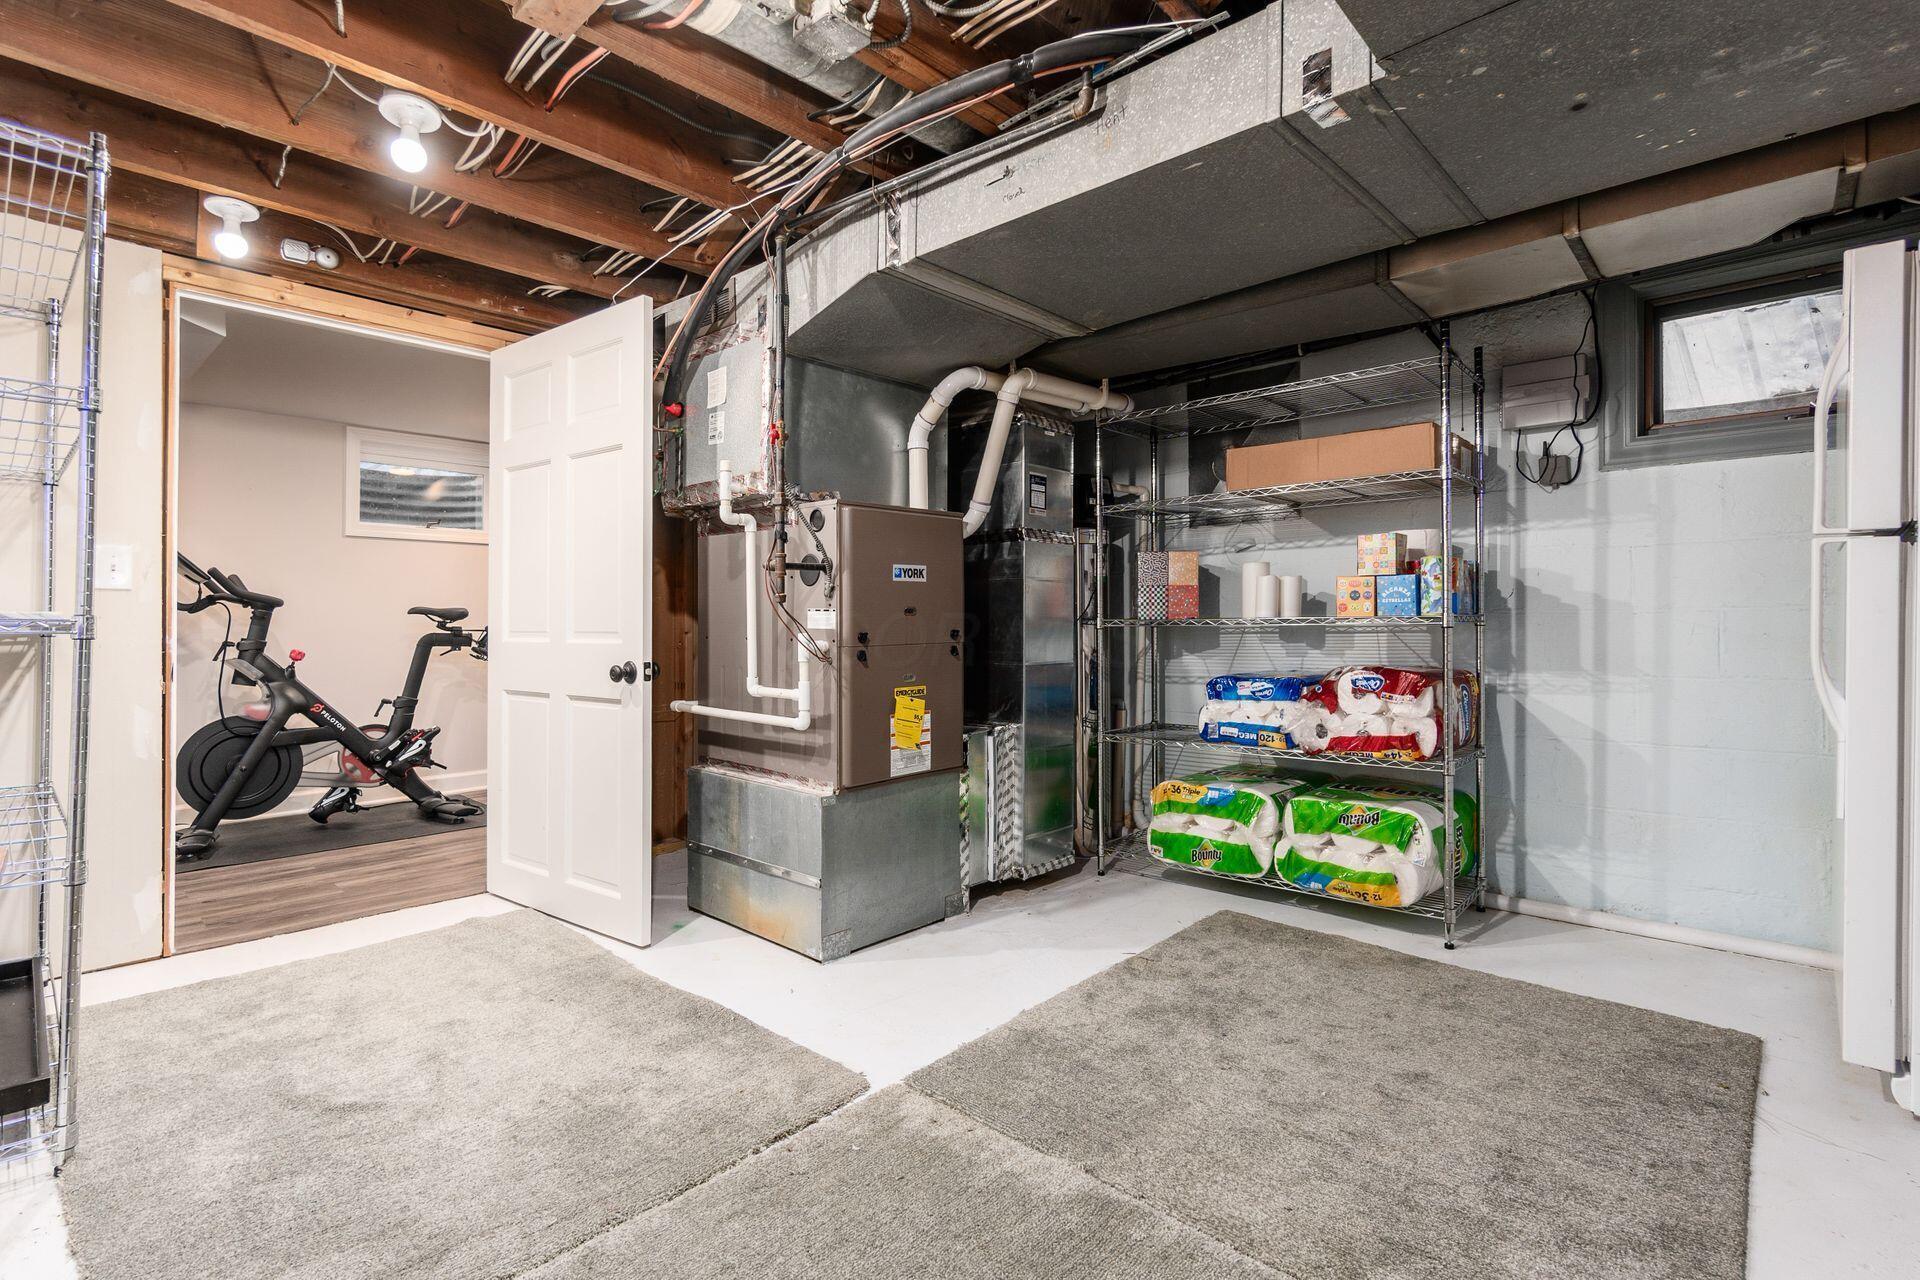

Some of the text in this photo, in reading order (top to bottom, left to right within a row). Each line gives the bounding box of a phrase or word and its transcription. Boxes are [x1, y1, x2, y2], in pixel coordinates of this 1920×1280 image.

[902, 568, 925, 579] YORK
[321, 710, 346, 732] PELOTON
[1238, 732, 1257, 740] MEG
[1259, 734, 1276, 743] 120
[1171, 784, 1182, 794] 36
[1338, 812, 1380, 826] Bounty
[1191, 849, 1222, 862] Bounty
